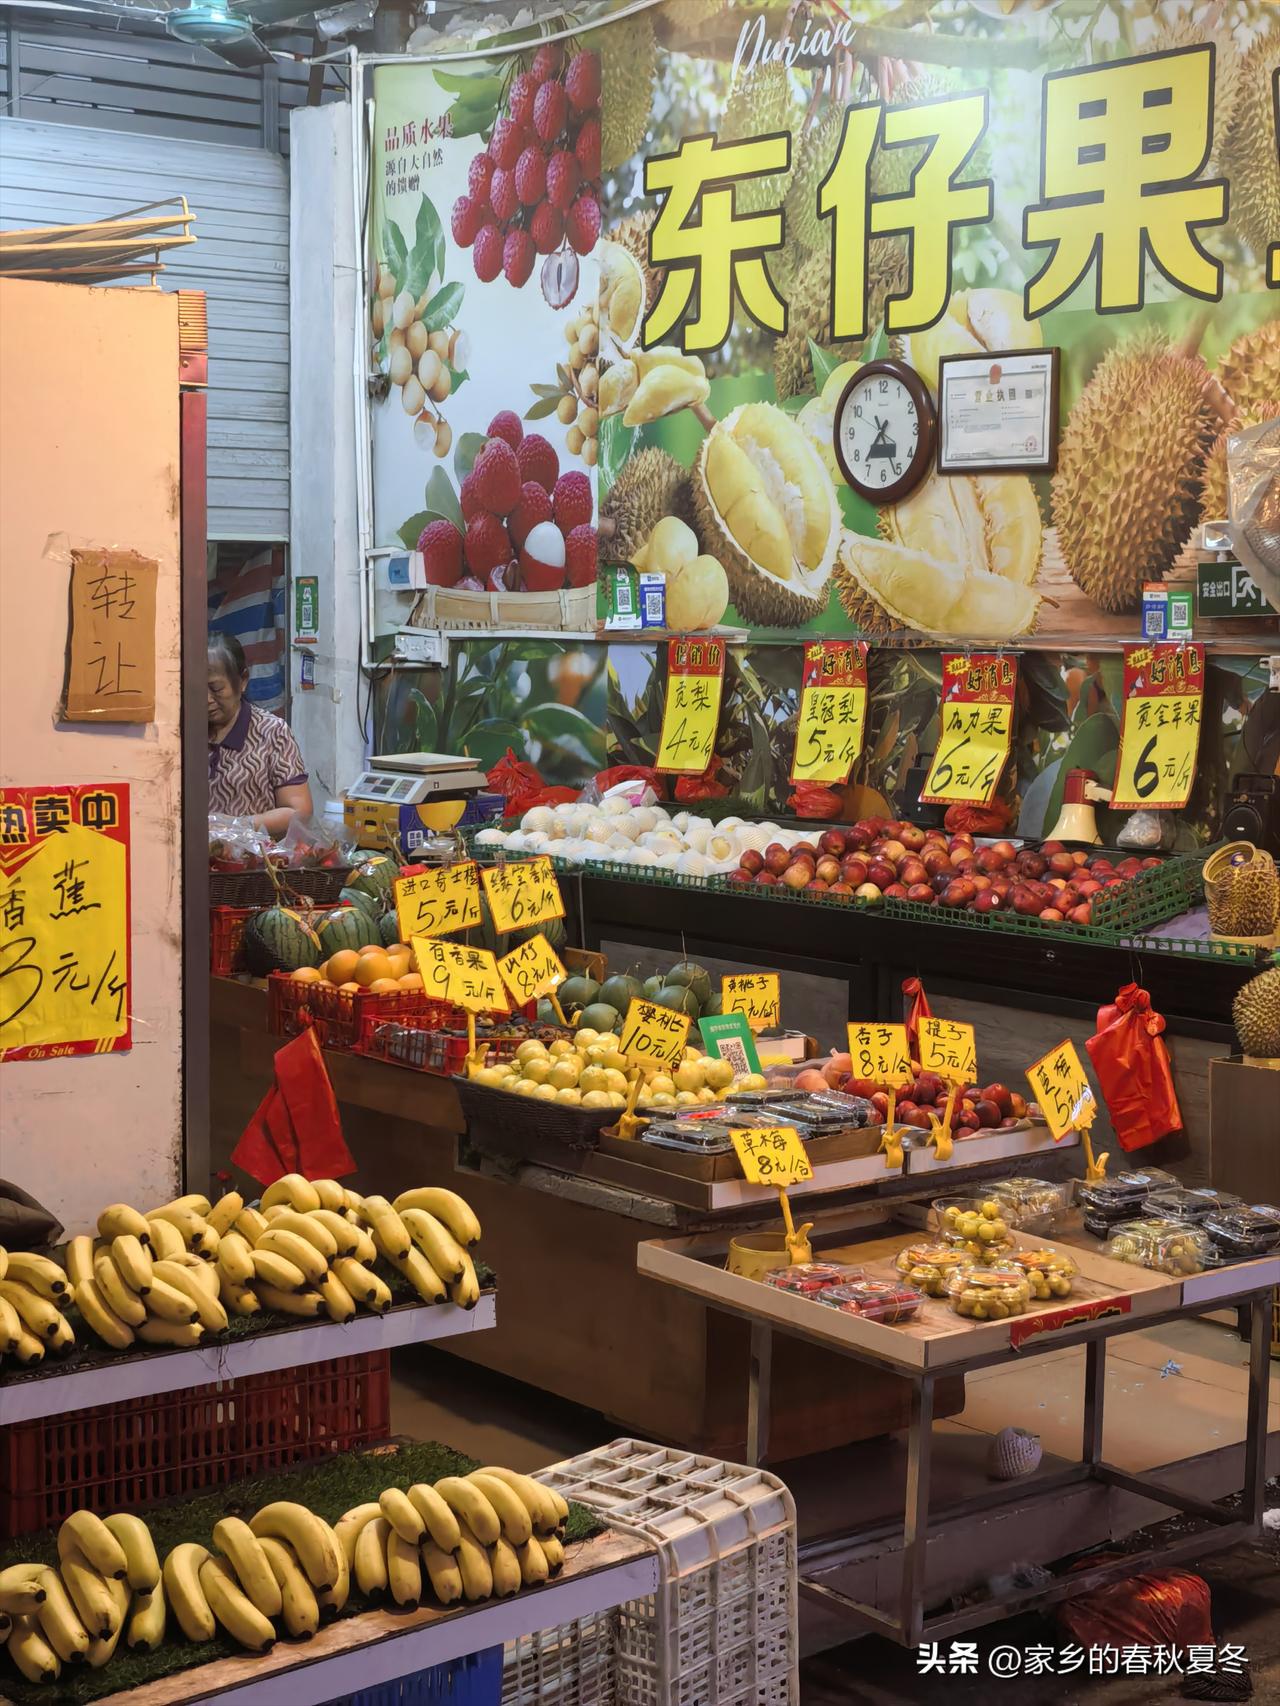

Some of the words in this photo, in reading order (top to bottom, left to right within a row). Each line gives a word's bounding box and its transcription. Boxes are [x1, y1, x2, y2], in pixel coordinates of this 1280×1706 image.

[731, 14, 857, 82] Durian
[385, 113, 454, 152] 品质水果
[385, 148, 443, 177] 源自大自然
[386, 174, 420, 197] 的馈赠
[641, 41, 1280, 355] 东仔果
[864, 389, 872, 401] 11
[879, 380, 889, 393] 12
[853, 405, 862, 418] 10
[907, 401, 914, 414] 2
[848, 427, 855, 440] 9
[912, 423, 919, 436] 3
[854, 449, 860, 462] 8
[907, 446, 913, 458] 4
[865, 464, 871, 477] 7
[880, 469, 886, 482] 6
[896, 463, 902, 475] 5
[1202, 581, 1230, 598] 安全出口
[87, 564, 142, 696] 转让
[967, 661, 1014, 691] 好消息
[1151, 651, 1201, 684] 好消息
[674, 680, 711, 711] 贡梨
[807, 691, 858, 724] 皇冠梨
[1136, 700, 1200, 730] 黄金苹果
[0, 790, 118, 844] 热卖中
[0, 859, 101, 931] 香蕉
[429, 942, 488, 971] 百香果
[28, 1046, 45, 1058] On
[50, 1045, 75, 1057] Sale
